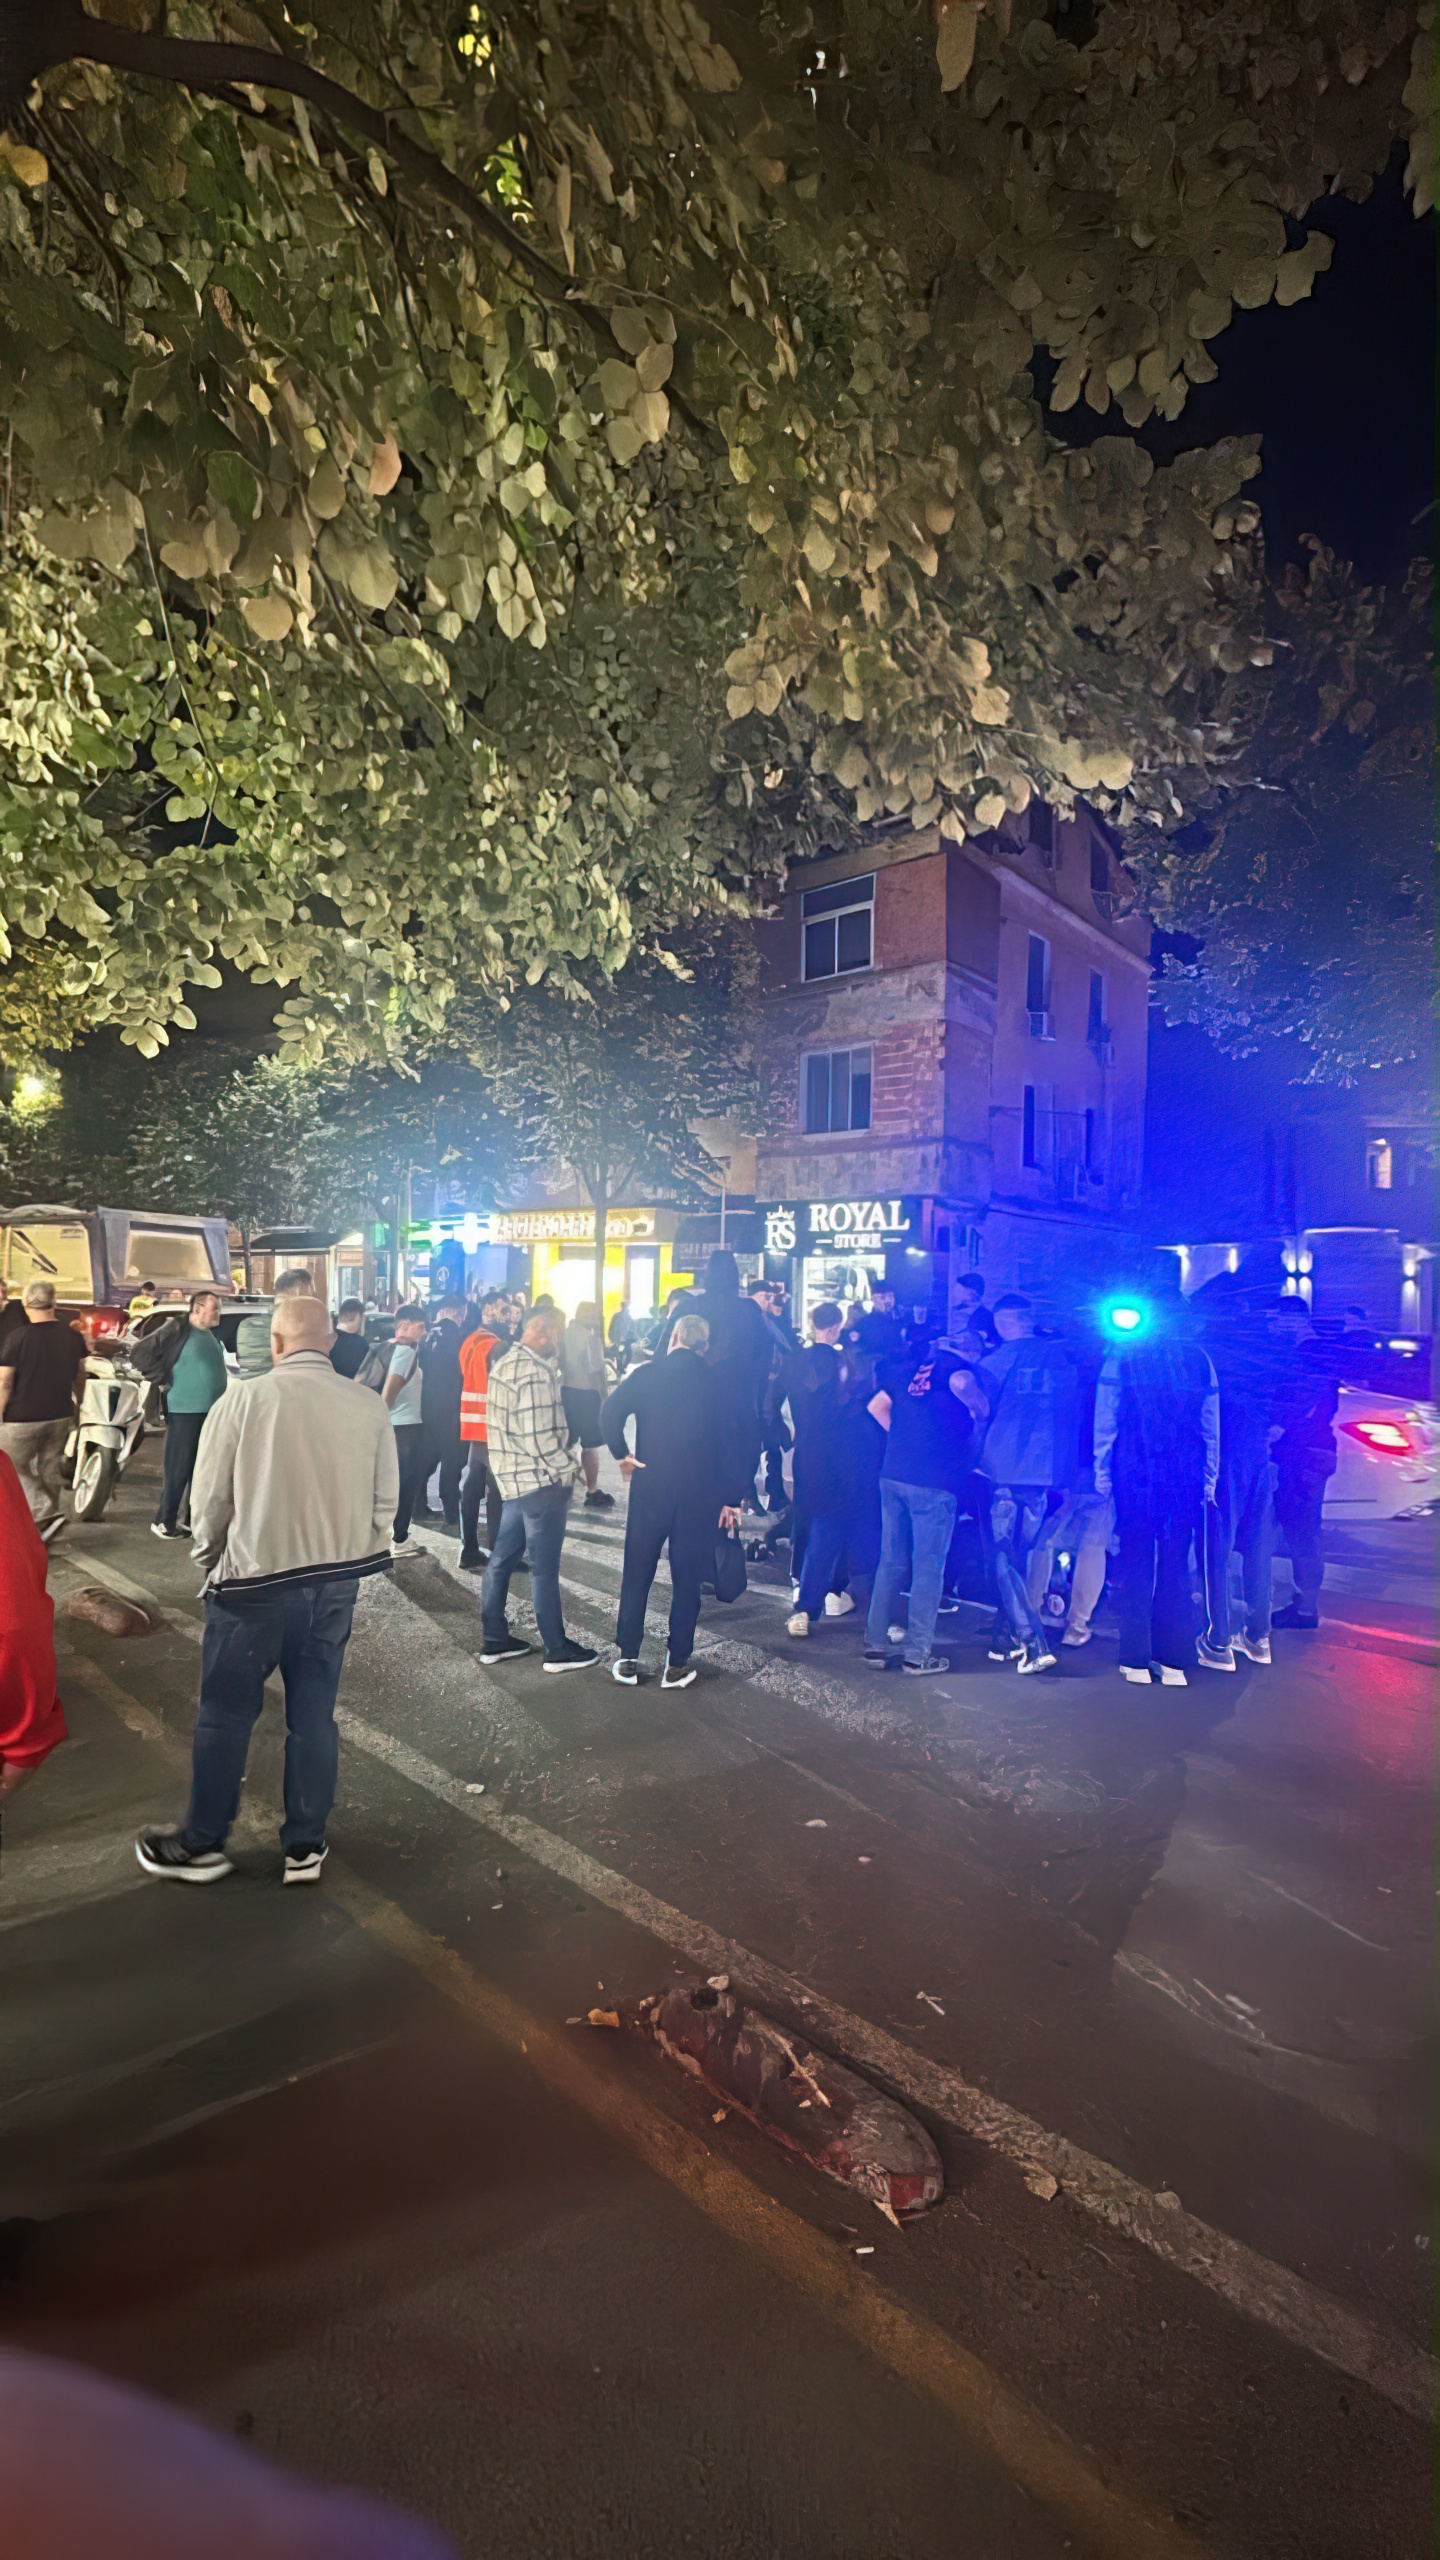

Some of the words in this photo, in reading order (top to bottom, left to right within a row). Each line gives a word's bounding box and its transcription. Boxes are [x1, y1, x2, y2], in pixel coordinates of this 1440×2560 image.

[809, 1200, 911, 1231] ROYAL
[764, 1220, 796, 1249] RS
[834, 1233, 882, 1248] STORE
